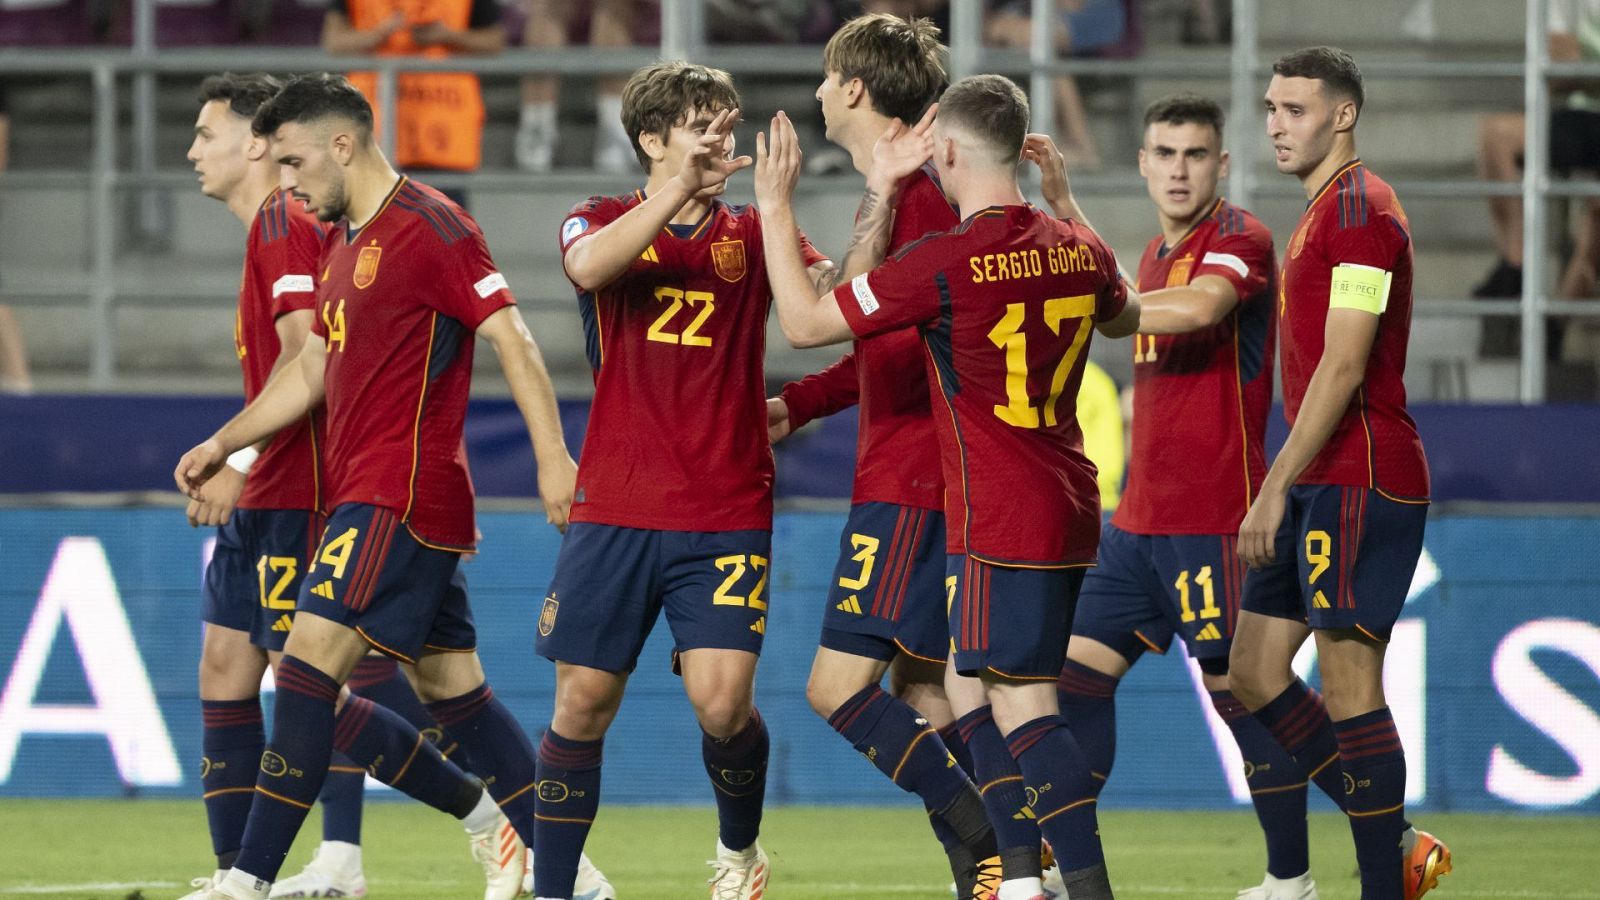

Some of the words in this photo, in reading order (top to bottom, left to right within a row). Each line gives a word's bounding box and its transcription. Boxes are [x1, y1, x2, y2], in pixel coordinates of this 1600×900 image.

[969, 249, 1042, 284] SERGIO
[1048, 242, 1096, 276] GÓMEZ
[647, 286, 715, 347] 22
[987, 294, 1096, 429] 17
[258, 556, 298, 610] 12
[712, 554, 769, 612] 22
[838, 533, 880, 591] 3
[1305, 530, 1332, 585] 9
[1174, 565, 1222, 623] 11
